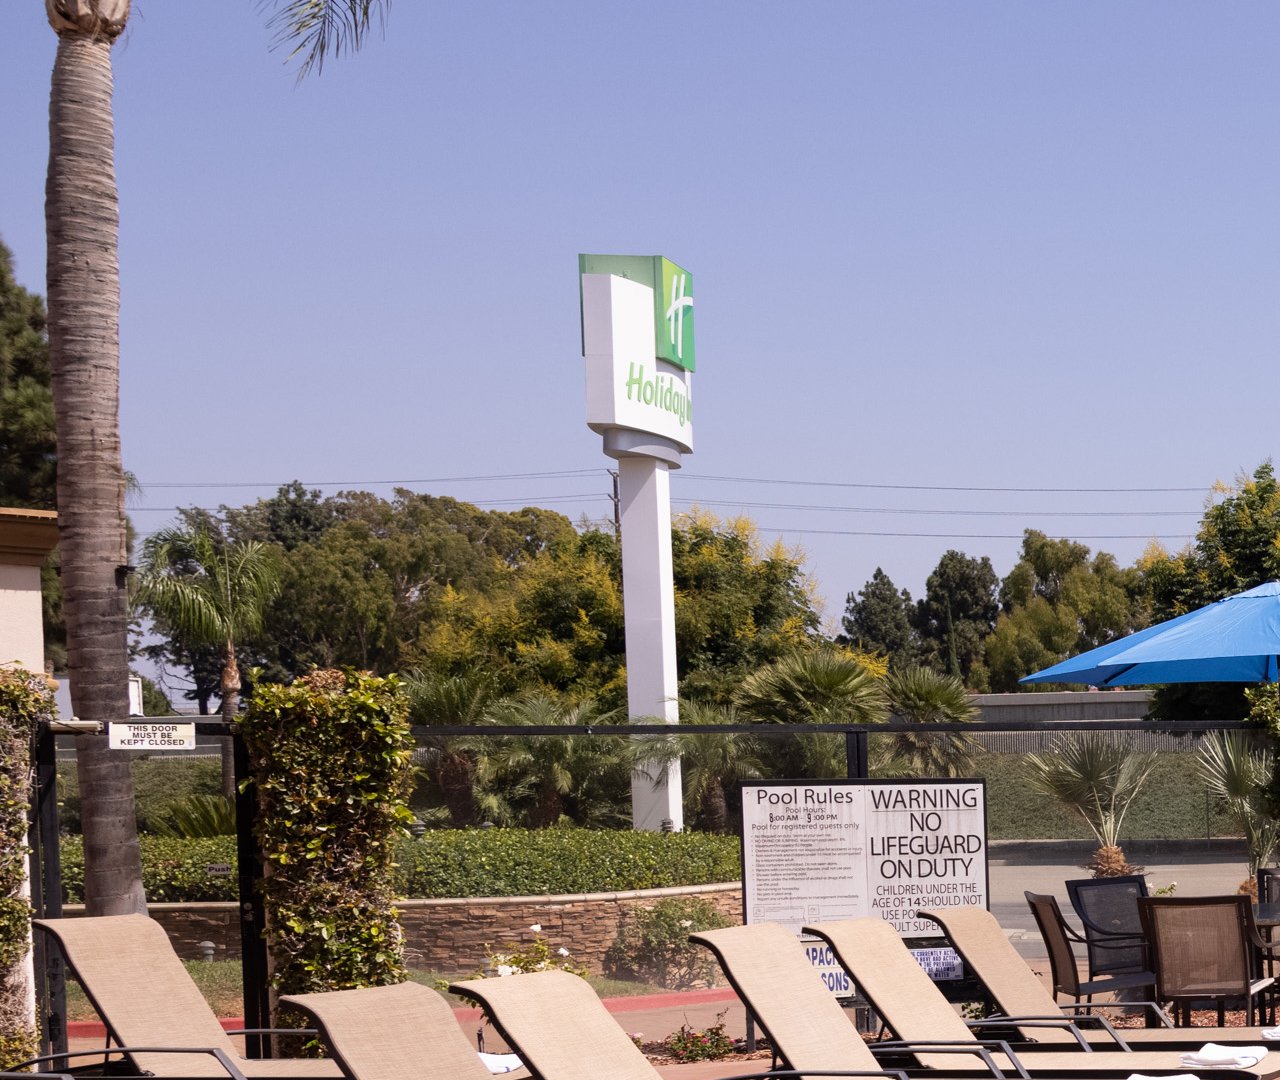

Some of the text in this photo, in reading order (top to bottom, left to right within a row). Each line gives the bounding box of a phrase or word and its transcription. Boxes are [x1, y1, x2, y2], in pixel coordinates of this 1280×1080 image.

[626, 361, 686, 427] Holiday
[757, 788, 853, 805] Pool Rules
[871, 788, 977, 809] WARNING
[781, 823, 818, 831] registered
[820, 823, 843, 831] guests
[844, 822, 859, 830] only
[910, 812, 942, 832] NO
[870, 834, 982, 856] LIFEGUARD
[880, 857, 974, 879] ON DUTY
[876, 883, 977, 896] CHILDREN UNDER THE
[872, 895, 982, 908] AGE OF 14 SHOULD NOT
[882, 910, 900, 920] USE
